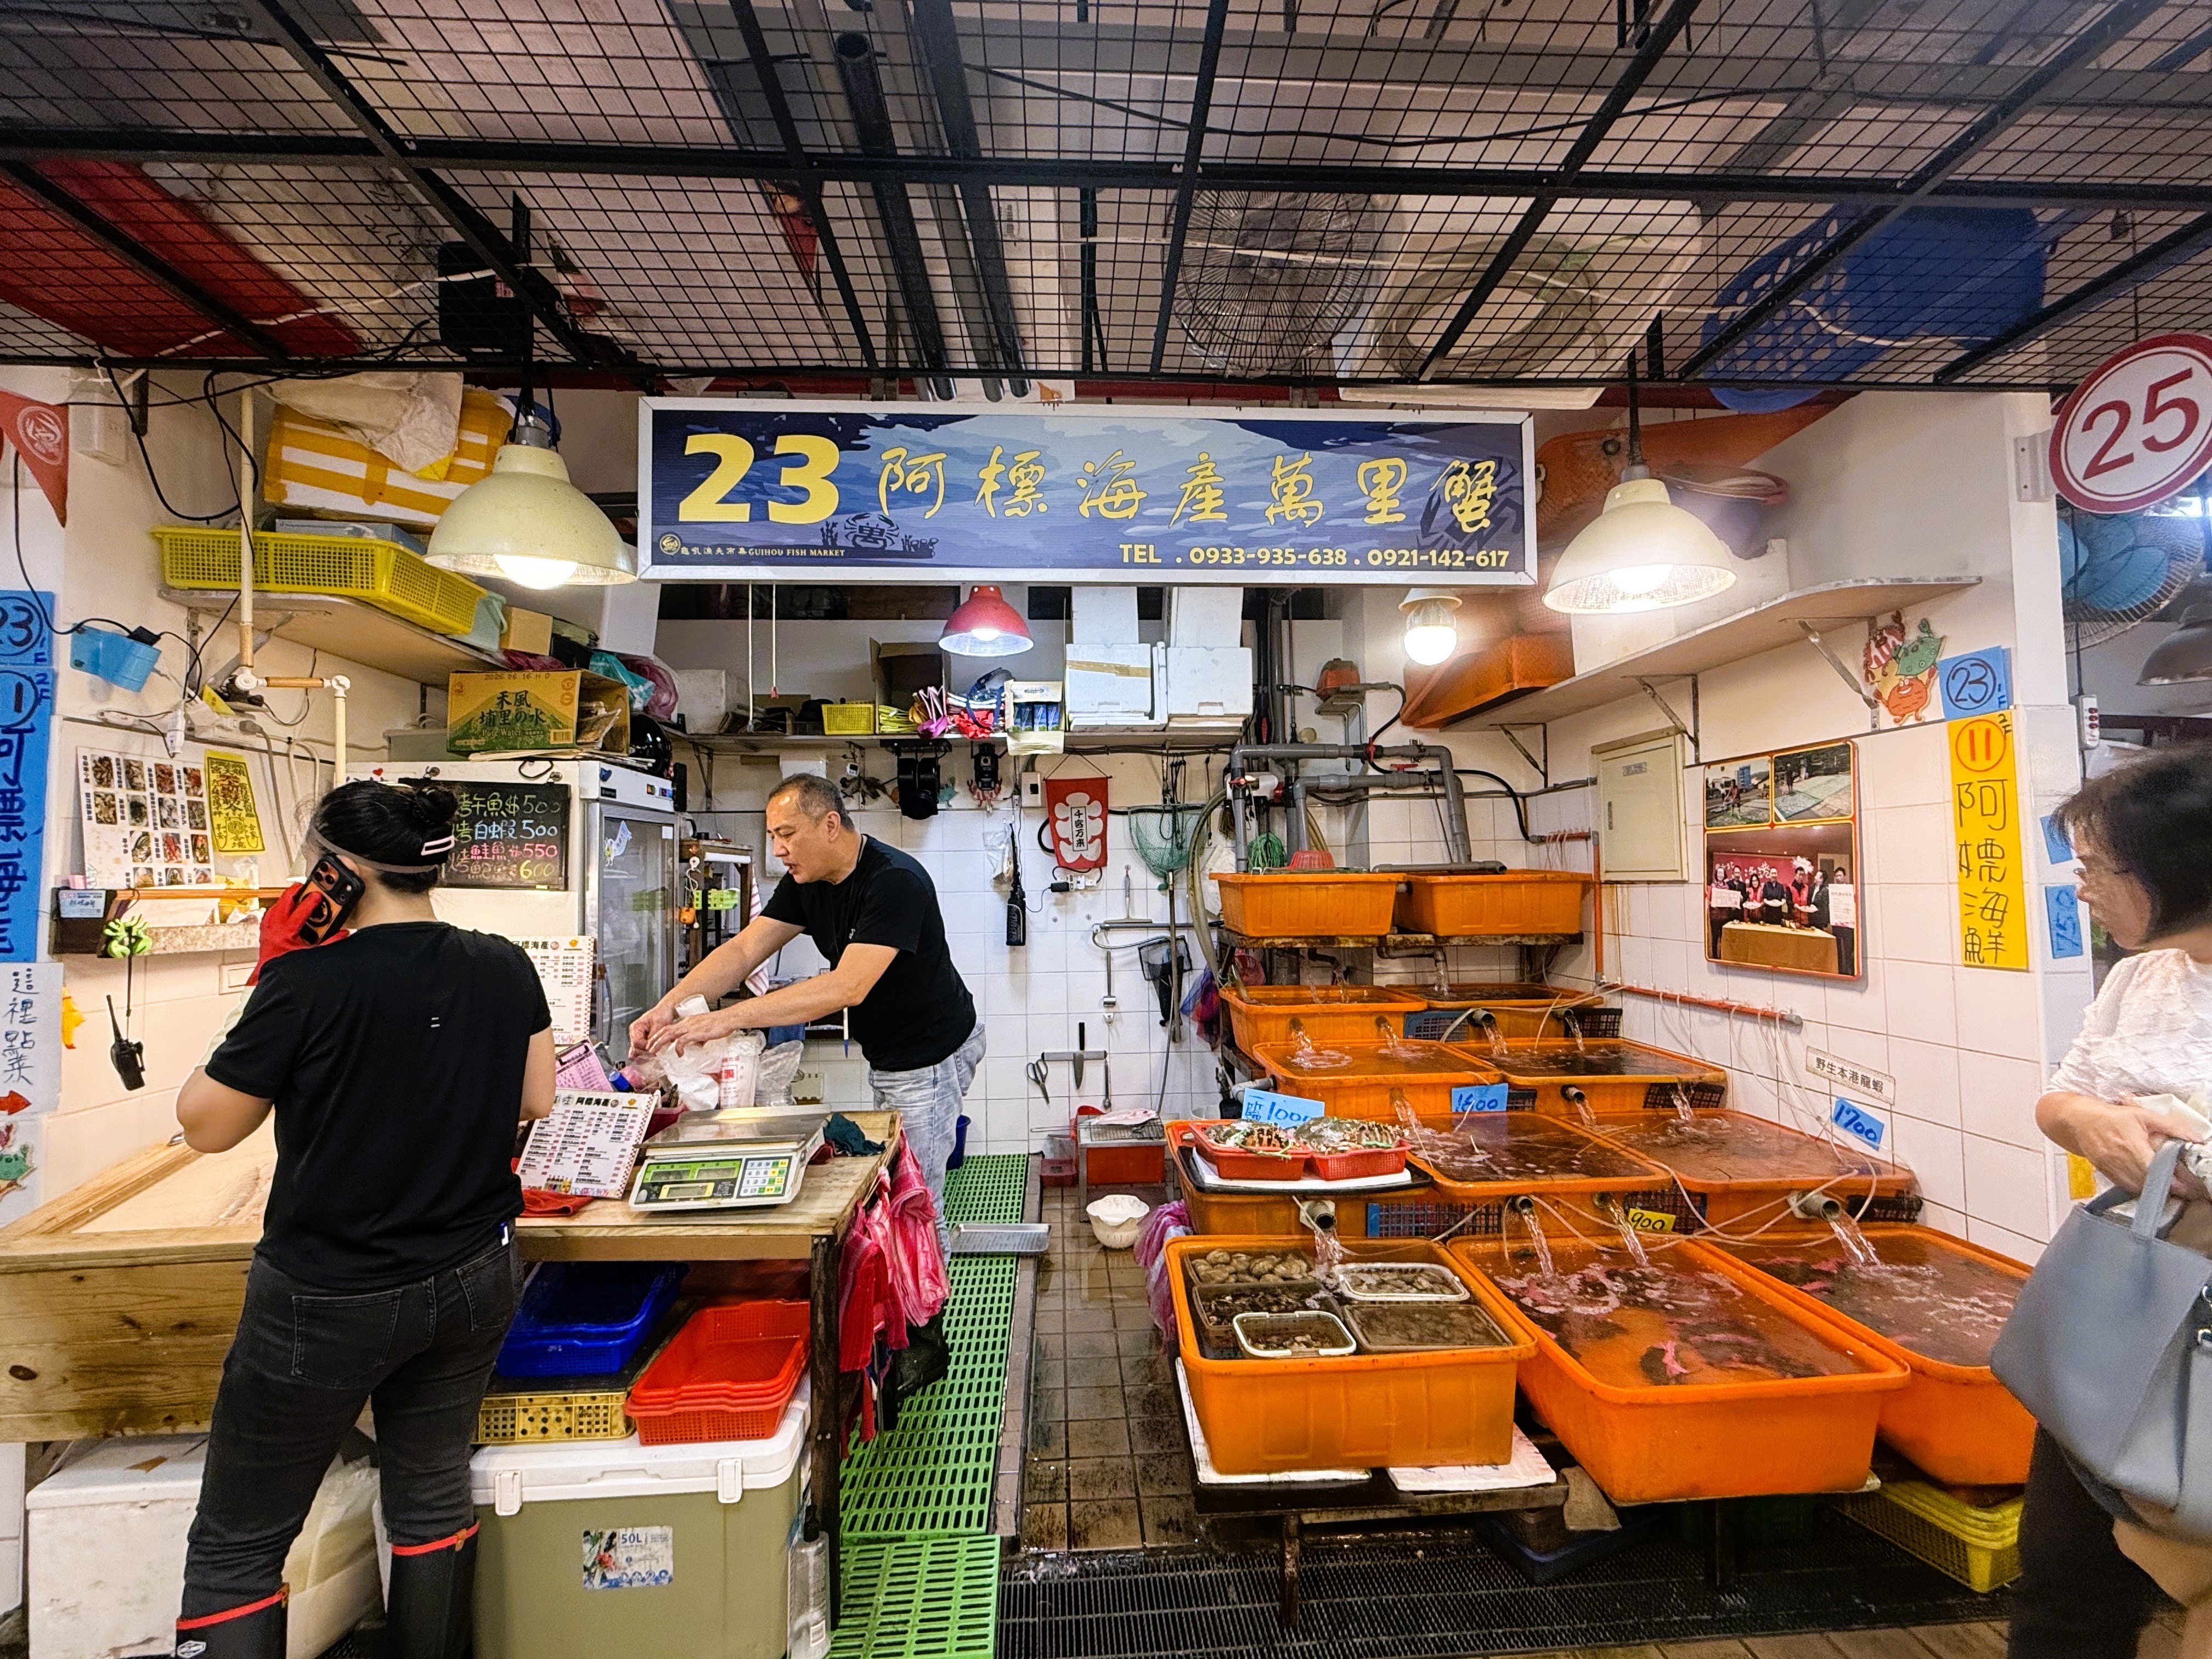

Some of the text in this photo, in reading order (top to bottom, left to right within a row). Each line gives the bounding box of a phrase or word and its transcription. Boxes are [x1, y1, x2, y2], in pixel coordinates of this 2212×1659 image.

[2082, 367, 2200, 481] 25
[679, 433, 840, 524] 23
[1119, 544, 1162, 563] TEL
[1951, 663, 1988, 703] 23
[1956, 778, 2008, 964] 阿標海鮮
[1816, 1057, 1884, 1094] 野生本港龍蝦
[1835, 1104, 1877, 1142] 1700
[1631, 1212, 1666, 1230] 900
[621, 1533, 642, 1544] 50L
